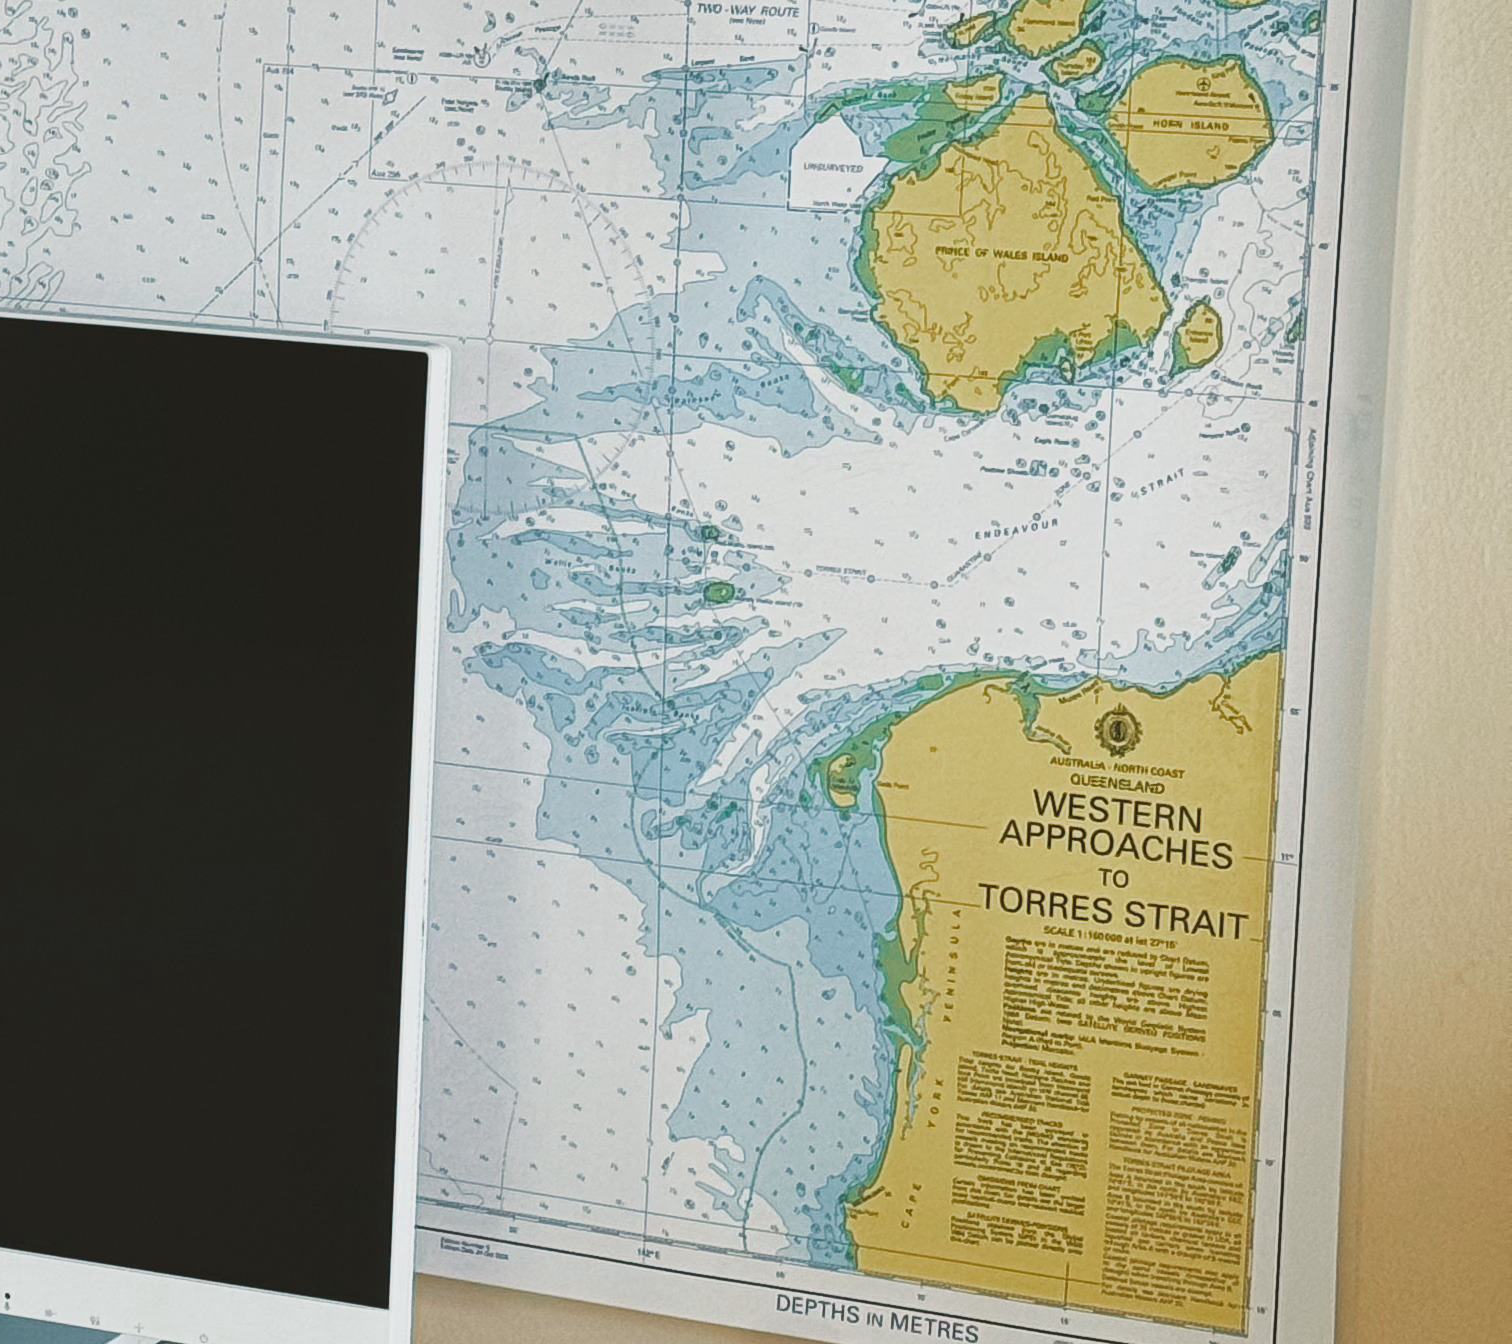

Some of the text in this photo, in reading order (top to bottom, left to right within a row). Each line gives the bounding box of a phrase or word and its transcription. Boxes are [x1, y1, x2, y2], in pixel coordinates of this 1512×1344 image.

[760, 7, 800, 18] ROUTE
[1190, 119, 1230, 132] ISLAND
[993, 249, 1028, 260] WALES
[1032, 252, 1069, 263] ISLAND
[975, 468, 1185, 539] ENDEAVOUR STRAIT
[1050, 756, 1186, 779] AUSTRALIA NORTH COAST
[1070, 773, 1165, 794] QUEENSLAND
[1033, 788, 1203, 833] WESTERN
[999, 818, 1233, 870] APPROACHES
[1098, 867, 1130, 888] TO
[978, 882, 1250, 940] TORRES STRAIT
[943, 908, 962, 1024] PENINSULA
[901, 1182, 922, 1230] CAPE
[776, 1293, 980, 1344] DEPTHS IN METRES
